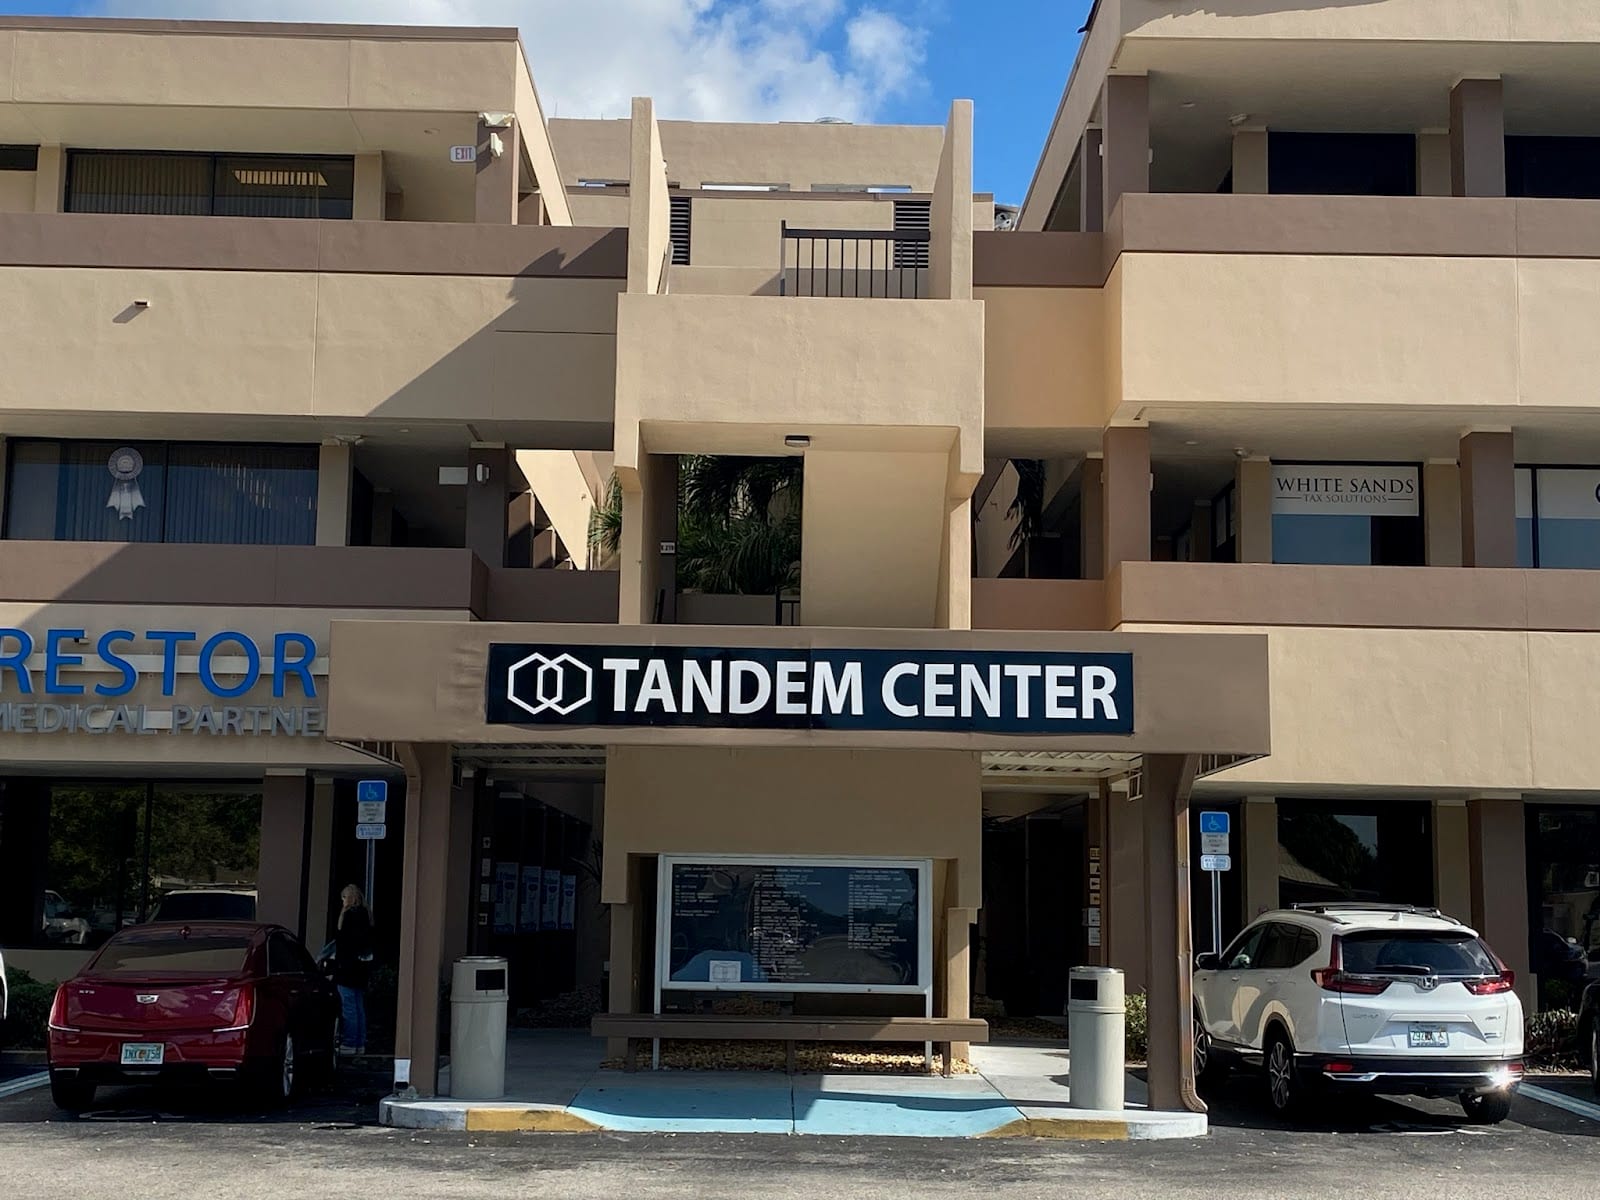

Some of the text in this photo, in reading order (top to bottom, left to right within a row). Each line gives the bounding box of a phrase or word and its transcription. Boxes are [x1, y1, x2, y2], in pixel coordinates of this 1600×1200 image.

[455, 147, 473, 160] EXIT
[1275, 478, 1415, 494] WHITE SANDS
[1302, 493, 1388, 505] TAX SOLUTIONS
[603, 658, 1119, 720] TANDEM CENTER
